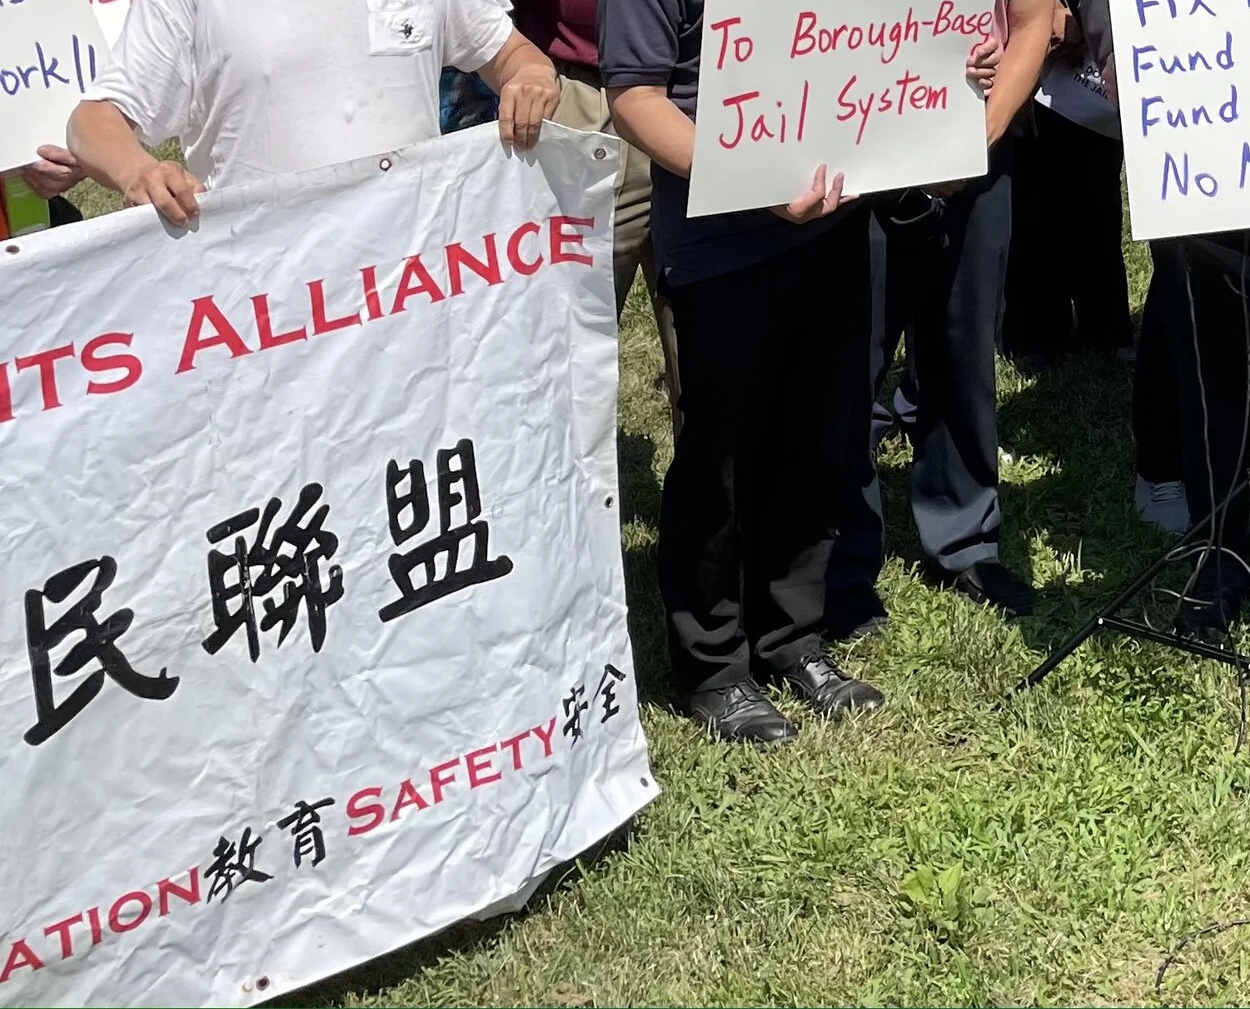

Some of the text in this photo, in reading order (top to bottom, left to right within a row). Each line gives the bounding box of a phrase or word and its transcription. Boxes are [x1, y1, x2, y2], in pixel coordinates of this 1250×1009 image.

[710, 17, 753, 70] To
[1132, 31, 1235, 83] Fund
[719, 70, 948, 149] Jail System
[1141, 84, 1238, 137] Fund
[1161, 151, 1218, 200] No
[174, 215, 596, 375] ALLIANCE
[562, 663, 626, 750] 安全
[346, 716, 557, 836] SAFETY
[204, 797, 336, 904] 教育
[0, 865, 201, 983] ATION
